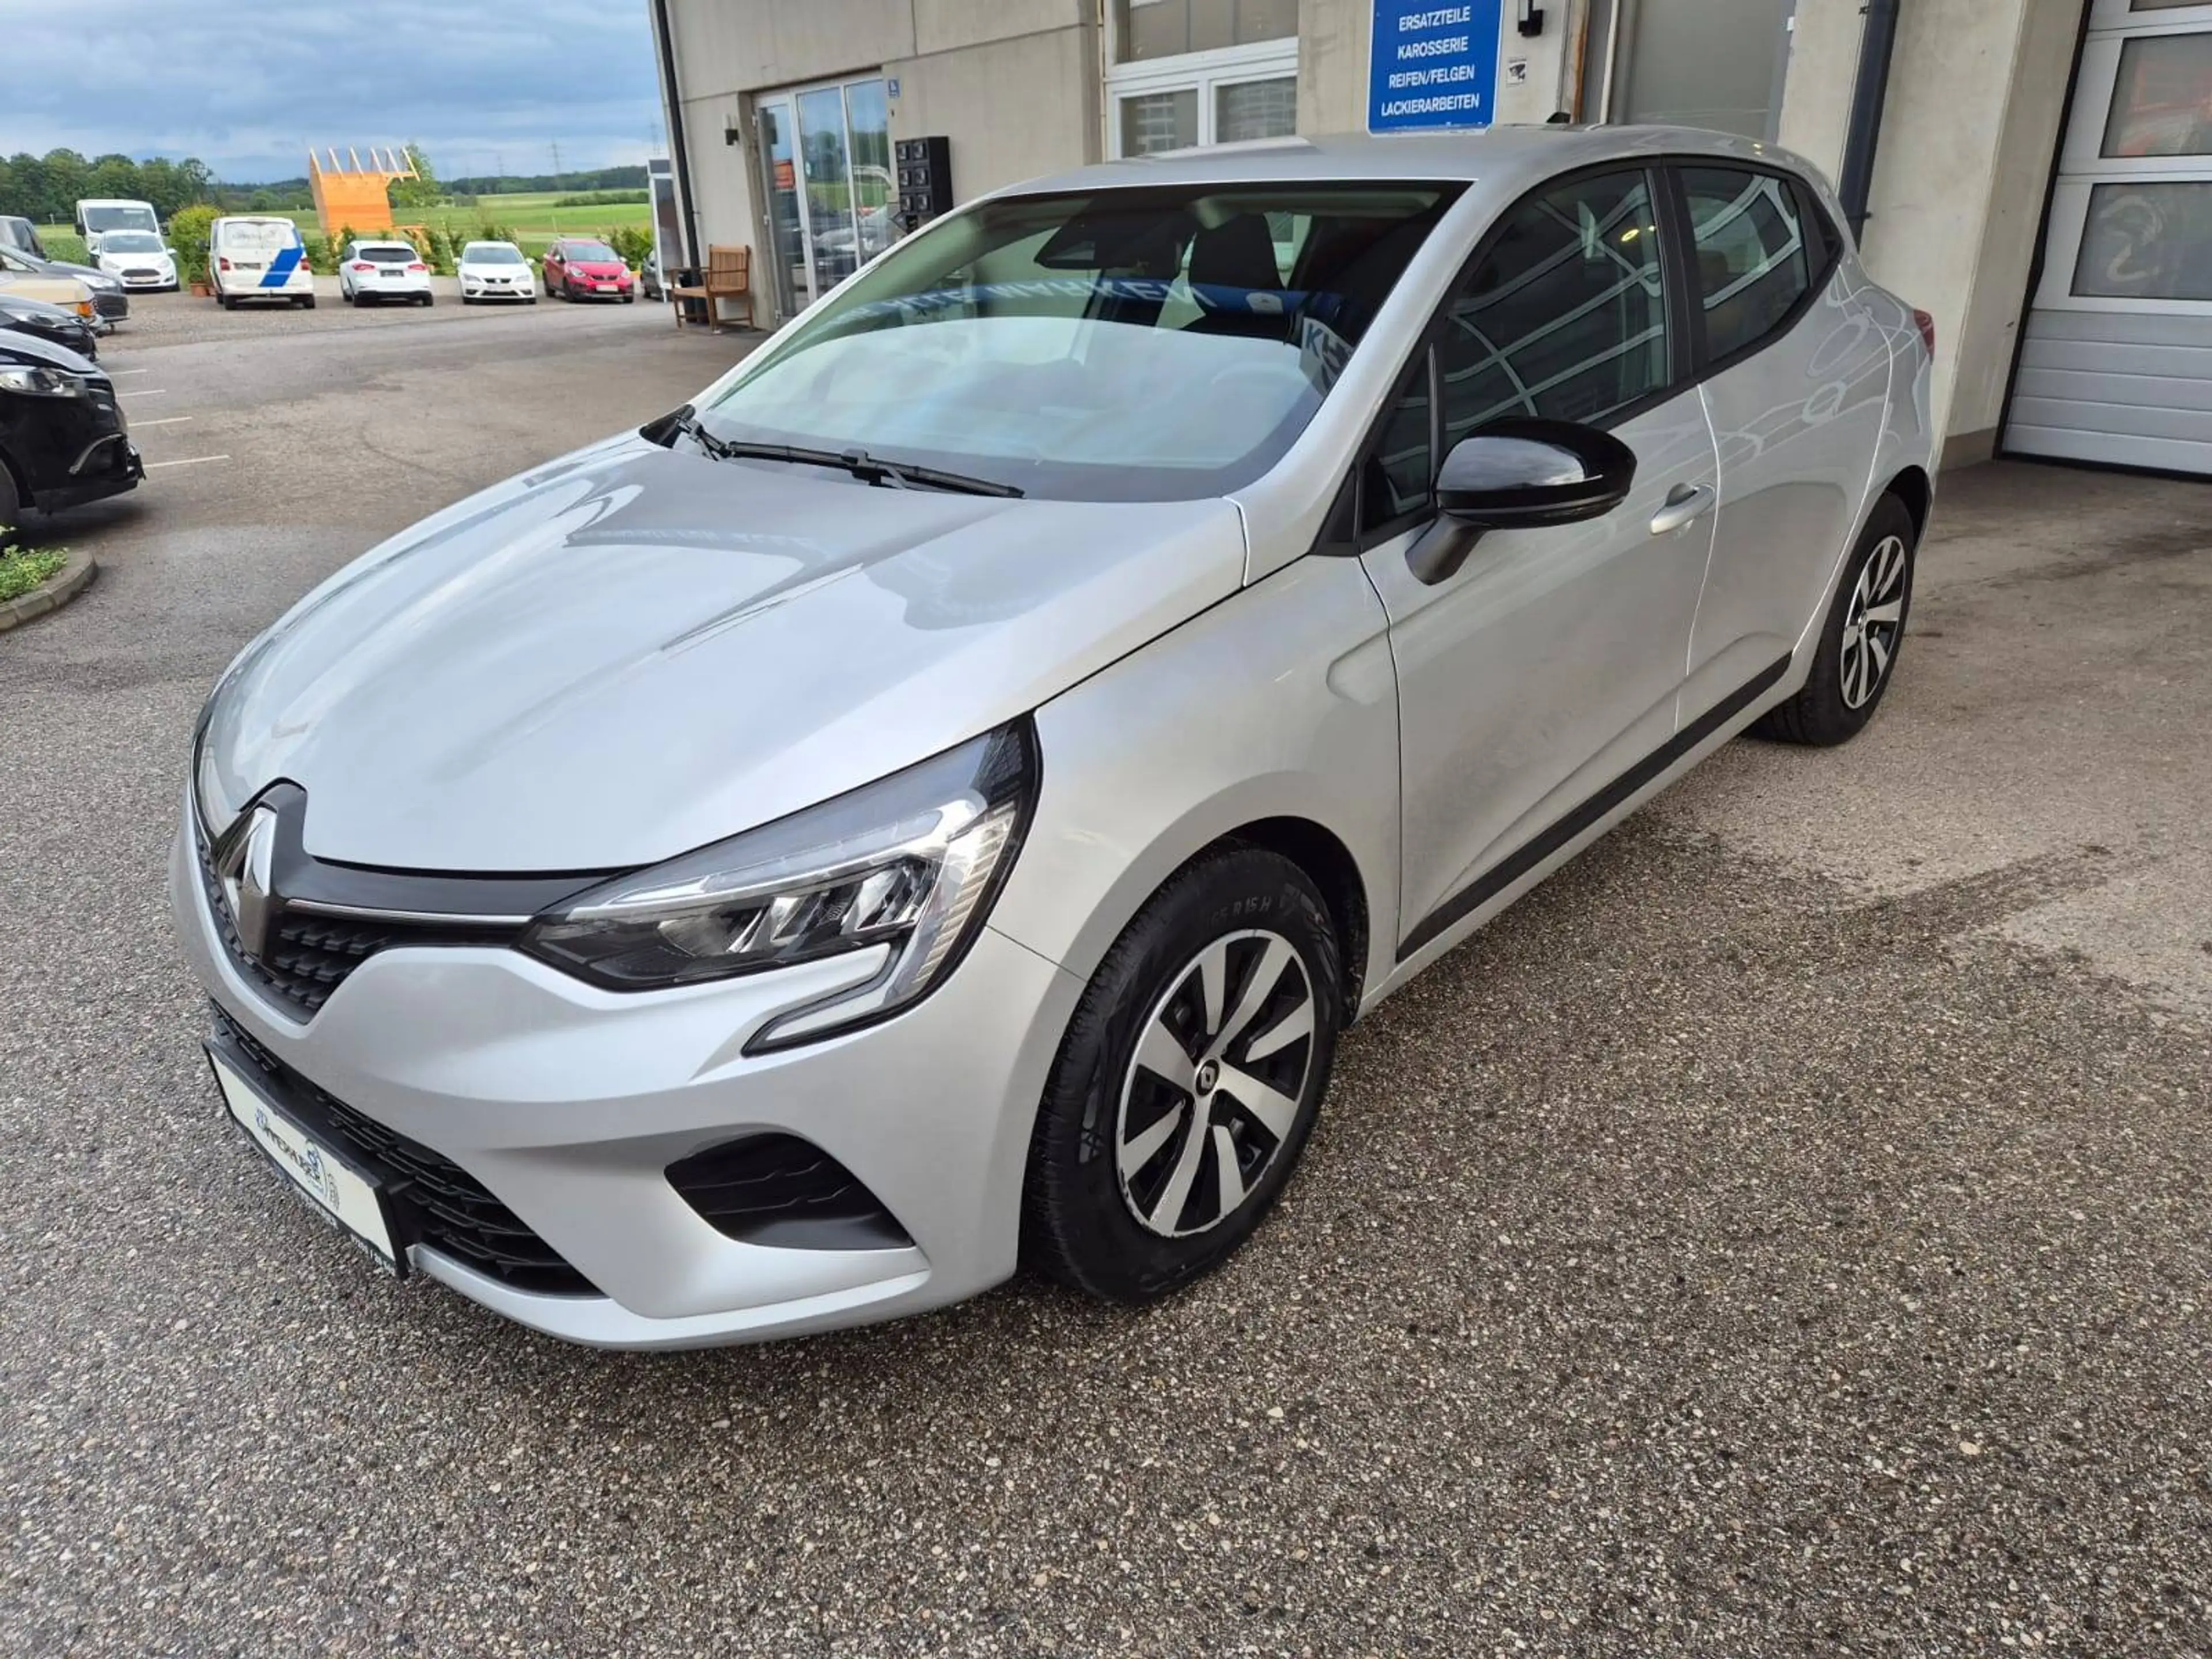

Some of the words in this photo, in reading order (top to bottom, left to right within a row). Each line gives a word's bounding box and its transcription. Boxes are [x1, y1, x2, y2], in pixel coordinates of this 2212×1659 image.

[1399, 6, 1471, 32] ERSATZTEILE
[1397, 36, 1469, 60] KAROSSERIE
[1389, 64, 1475, 89] REIFEN/FELGEN
[1381, 93, 1480, 117] LACKIERARBEITEN
